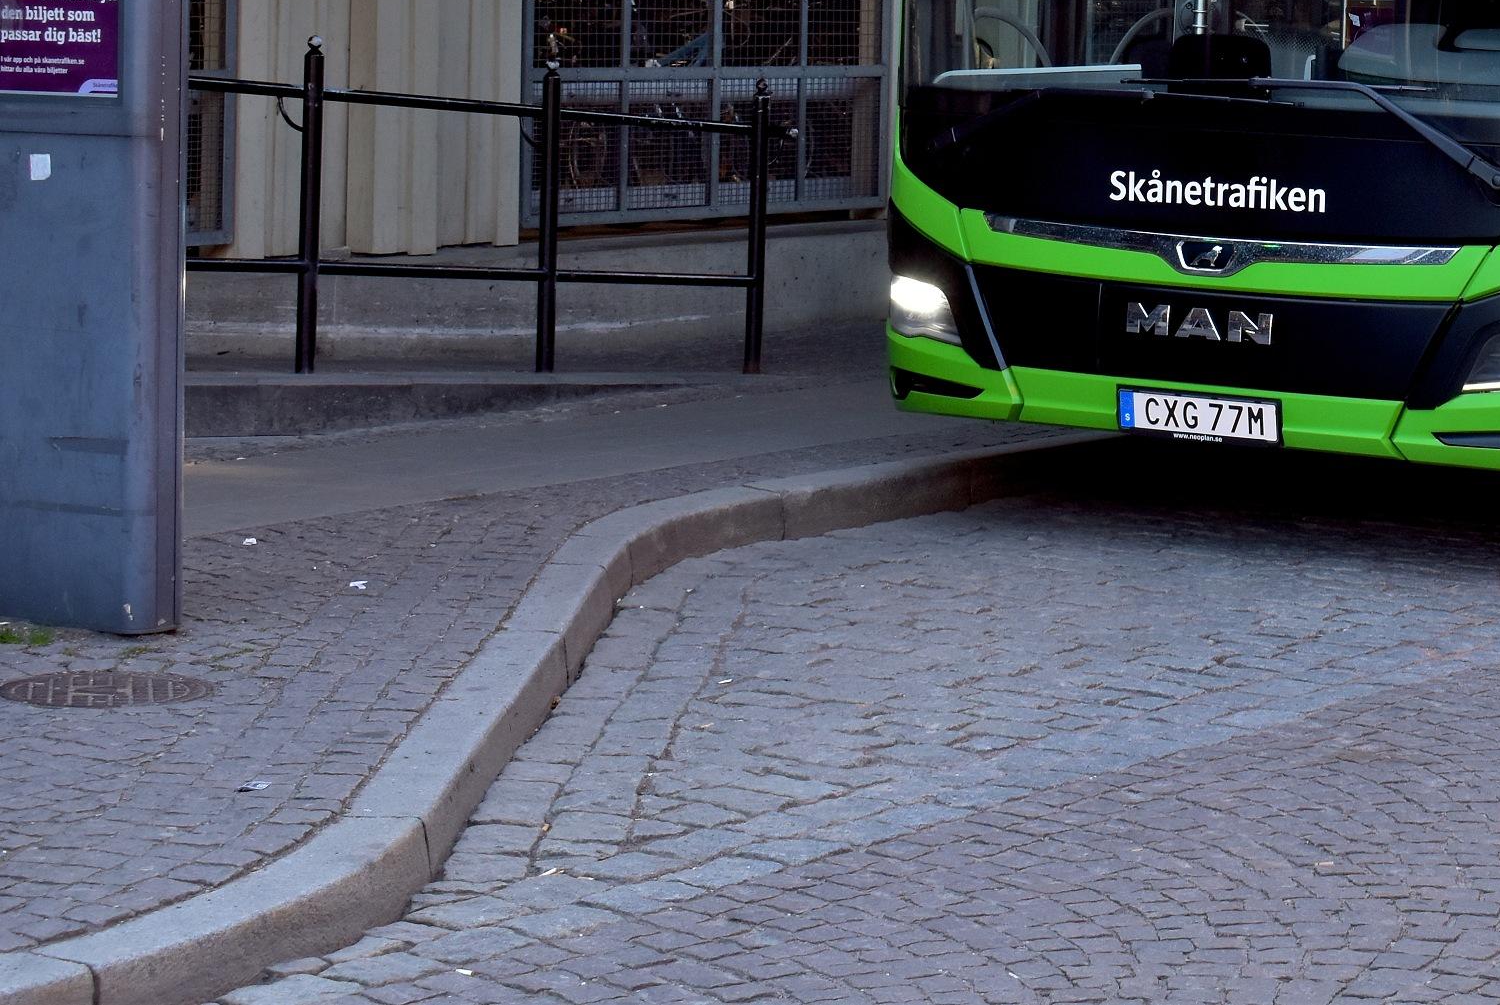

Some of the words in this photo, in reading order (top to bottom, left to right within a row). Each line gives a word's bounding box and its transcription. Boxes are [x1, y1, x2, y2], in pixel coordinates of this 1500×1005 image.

[1, 5, 23, 20] den
[25, 6, 65, 23] biljett
[67, 10, 95, 22] som
[0, 28, 42, 43] passar
[44, 27, 66, 45] dig
[68, 27, 101, 43] bäst!
[34, 56, 41, 64] på
[1109, 169, 1326, 213] Skånetrafiken
[1126, 302, 1273, 346] MAN
[1125, 413, 1131, 421] S
[1145, 397, 1199, 429] CXG
[1208, 402, 1265, 436] 77M
[1173, 432, 1223, 443] www.neoplan.se
